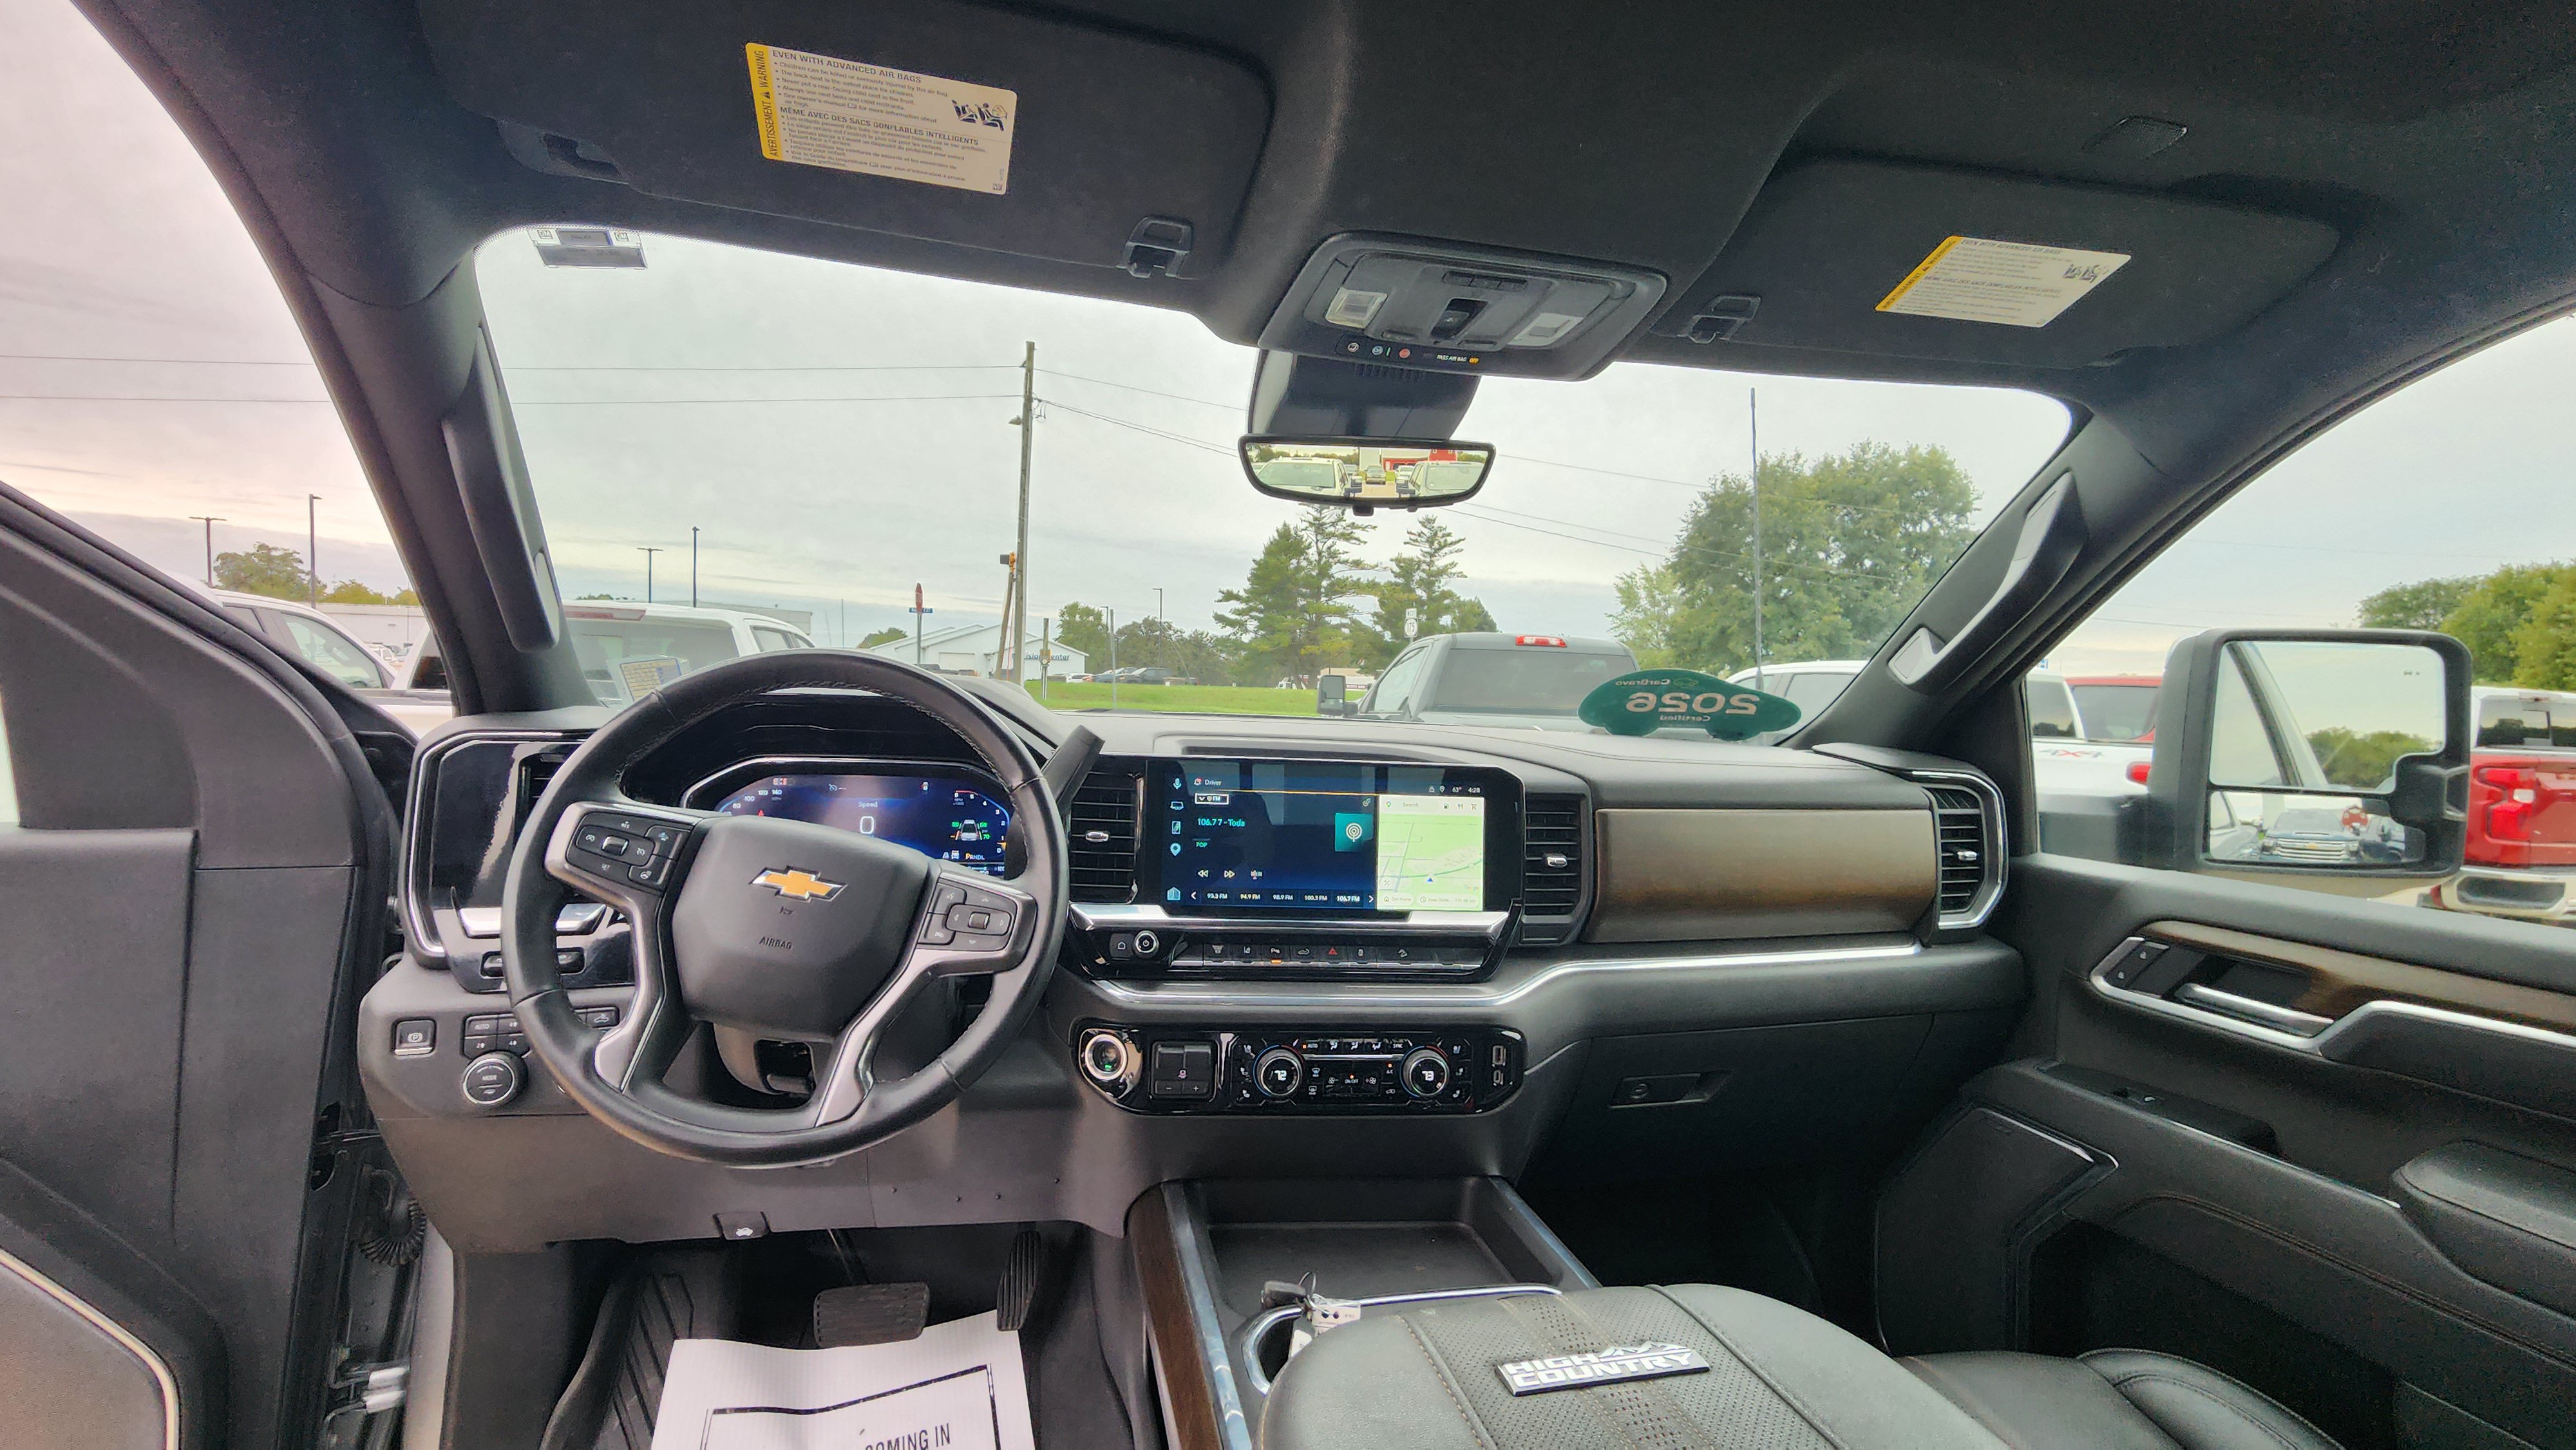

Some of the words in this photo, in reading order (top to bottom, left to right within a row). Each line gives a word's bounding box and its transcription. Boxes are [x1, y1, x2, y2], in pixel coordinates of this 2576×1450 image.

[753, 49, 770, 89] WARNING
[772, 50, 797, 61] EVEN
[799, 54, 824, 66] WITH
[826, 59, 876, 75] ADVANCED
[878, 69, 895, 78] AIR
[897, 72, 921, 83] BAGS
[761, 100, 779, 157] AVERTISSEMENT
[779, 104, 805, 116] MÊME
[807, 110, 829, 120] AVEC
[831, 114, 848, 122] DES
[849, 117, 870, 126] SACS
[873, 121, 923, 136] GONFLABLES
[926, 130, 979, 146] INTELLIGENTS
[1050, 653, 1070, 661] enter
[858, 800, 878, 809] Speed
[859, 816, 875, 835] 0
[1229, 818, 1245, 827] Toda
[759, 936, 792, 950] AIRBAG
[1274, 1070, 1287, 1081] 72
[1504, 1353, 1601, 1375] HIGH
[1511, 1352, 1693, 1388] COUNTRY
[865, 1429, 929, 1450] MING
[934, 1422, 951, 1447] IN
